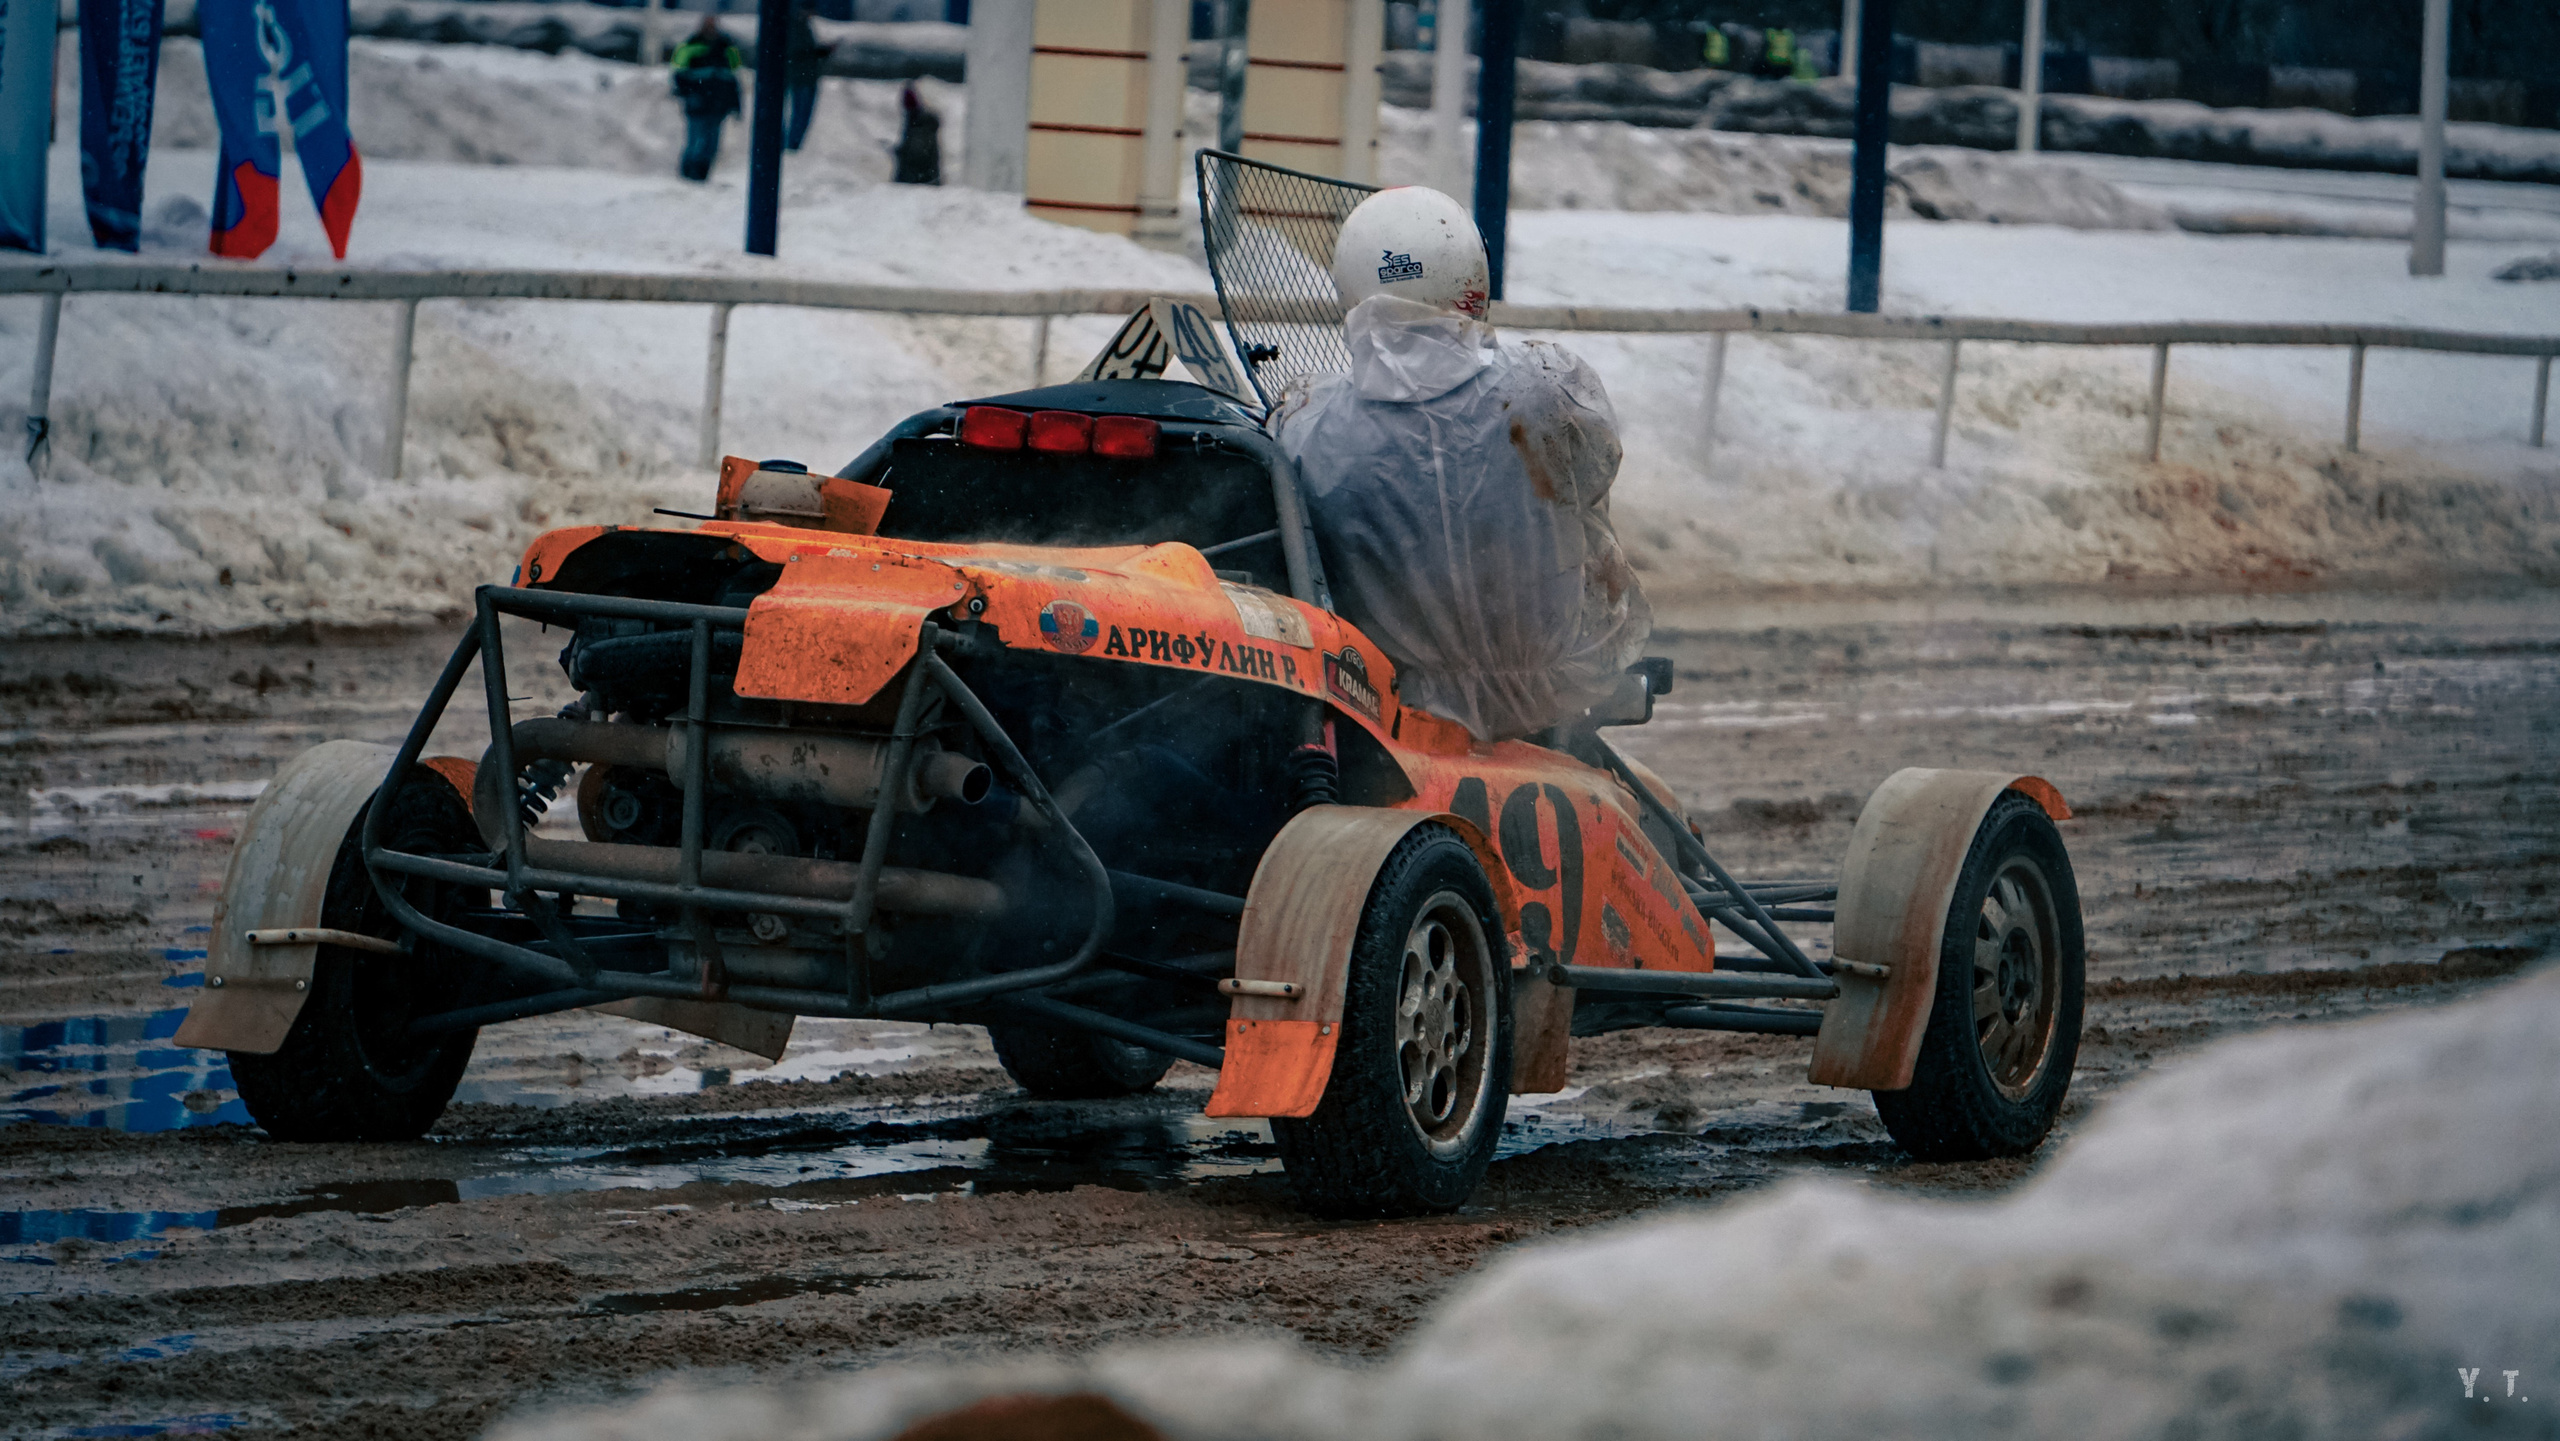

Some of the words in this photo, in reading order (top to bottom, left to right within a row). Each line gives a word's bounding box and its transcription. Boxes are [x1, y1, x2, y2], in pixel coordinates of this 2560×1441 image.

[1380, 263, 1421, 278] sparco
[1172, 303, 1239, 394] 49
[1104, 624, 1277, 682] АРИФУЛИН
[1280, 655, 1306, 689] Р.
